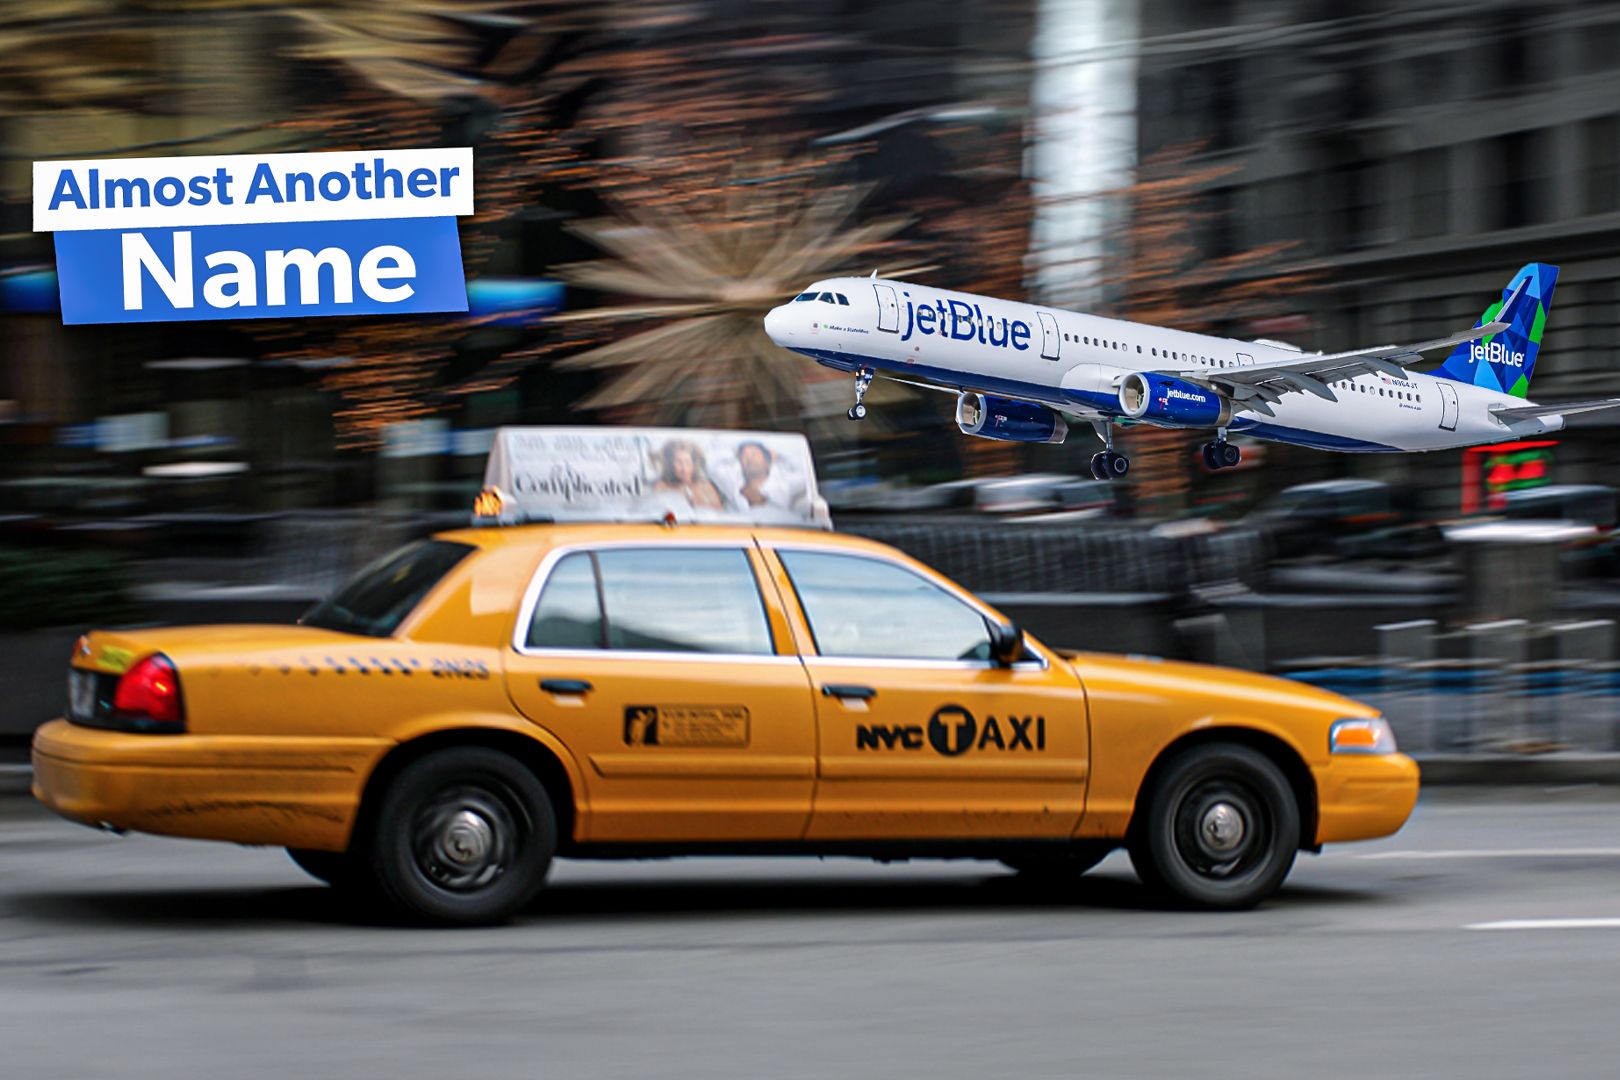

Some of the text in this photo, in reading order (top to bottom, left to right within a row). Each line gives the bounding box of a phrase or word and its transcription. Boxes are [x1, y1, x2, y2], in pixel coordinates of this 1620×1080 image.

[901, 291, 1031, 351] jetBlue
[1468, 340, 1524, 368] jetBlue
[1166, 388, 1206, 403] jetblue.com
[856, 709, 1046, 753] NYC TAXI
